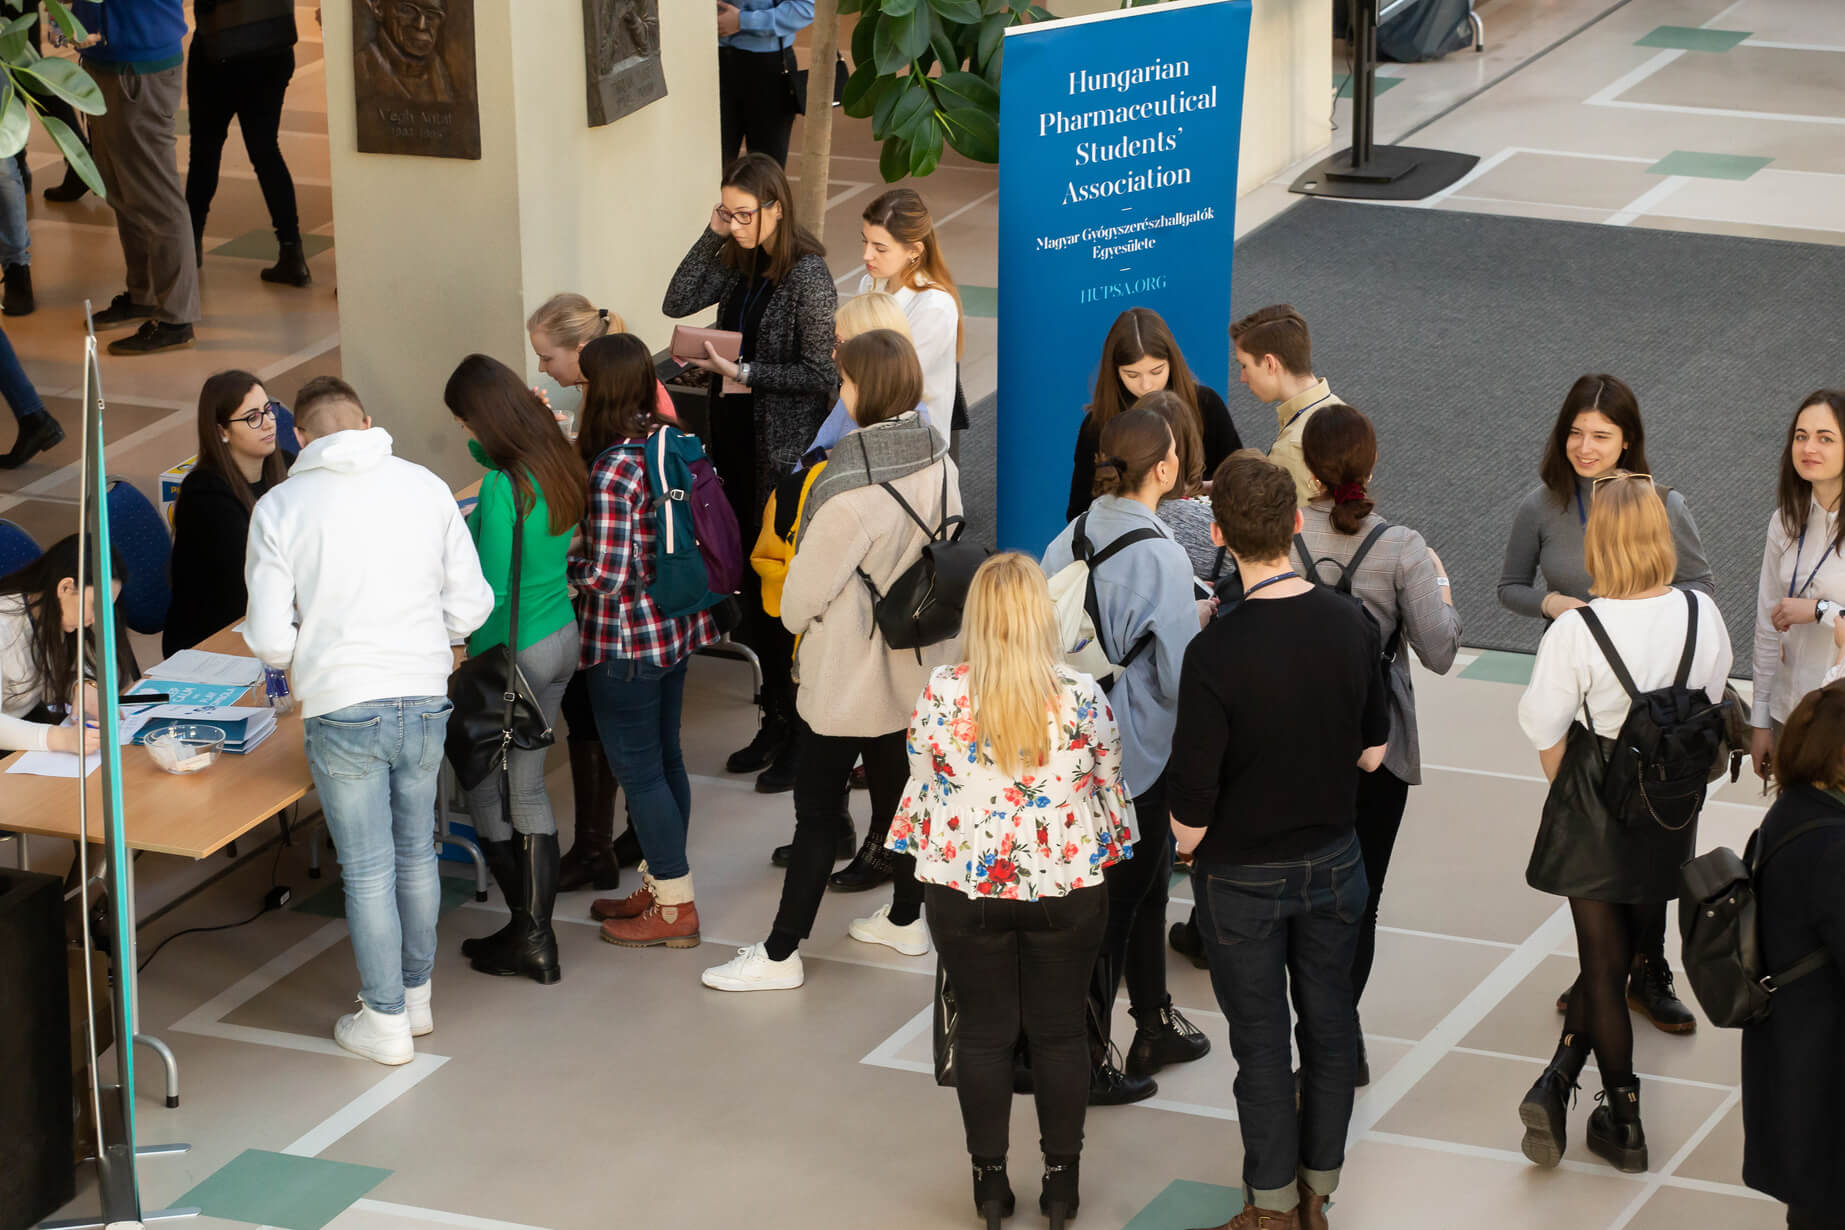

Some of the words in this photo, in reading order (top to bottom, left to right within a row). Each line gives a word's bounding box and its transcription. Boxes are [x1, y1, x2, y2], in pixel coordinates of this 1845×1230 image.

[1069, 58, 1189, 95] Hungarian
[1039, 85, 1217, 137] Pharmaceutical
[1075, 127, 1183, 166] Students’
[1062, 165, 1191, 205] Association
[1036, 233, 1080, 251] Magyar
[1082, 207, 1214, 243] Gyógyszerészhallgatók
[1092, 237, 1156, 260] Egyesülete
[1080, 275, 1167, 304] HUPSA.ORG
